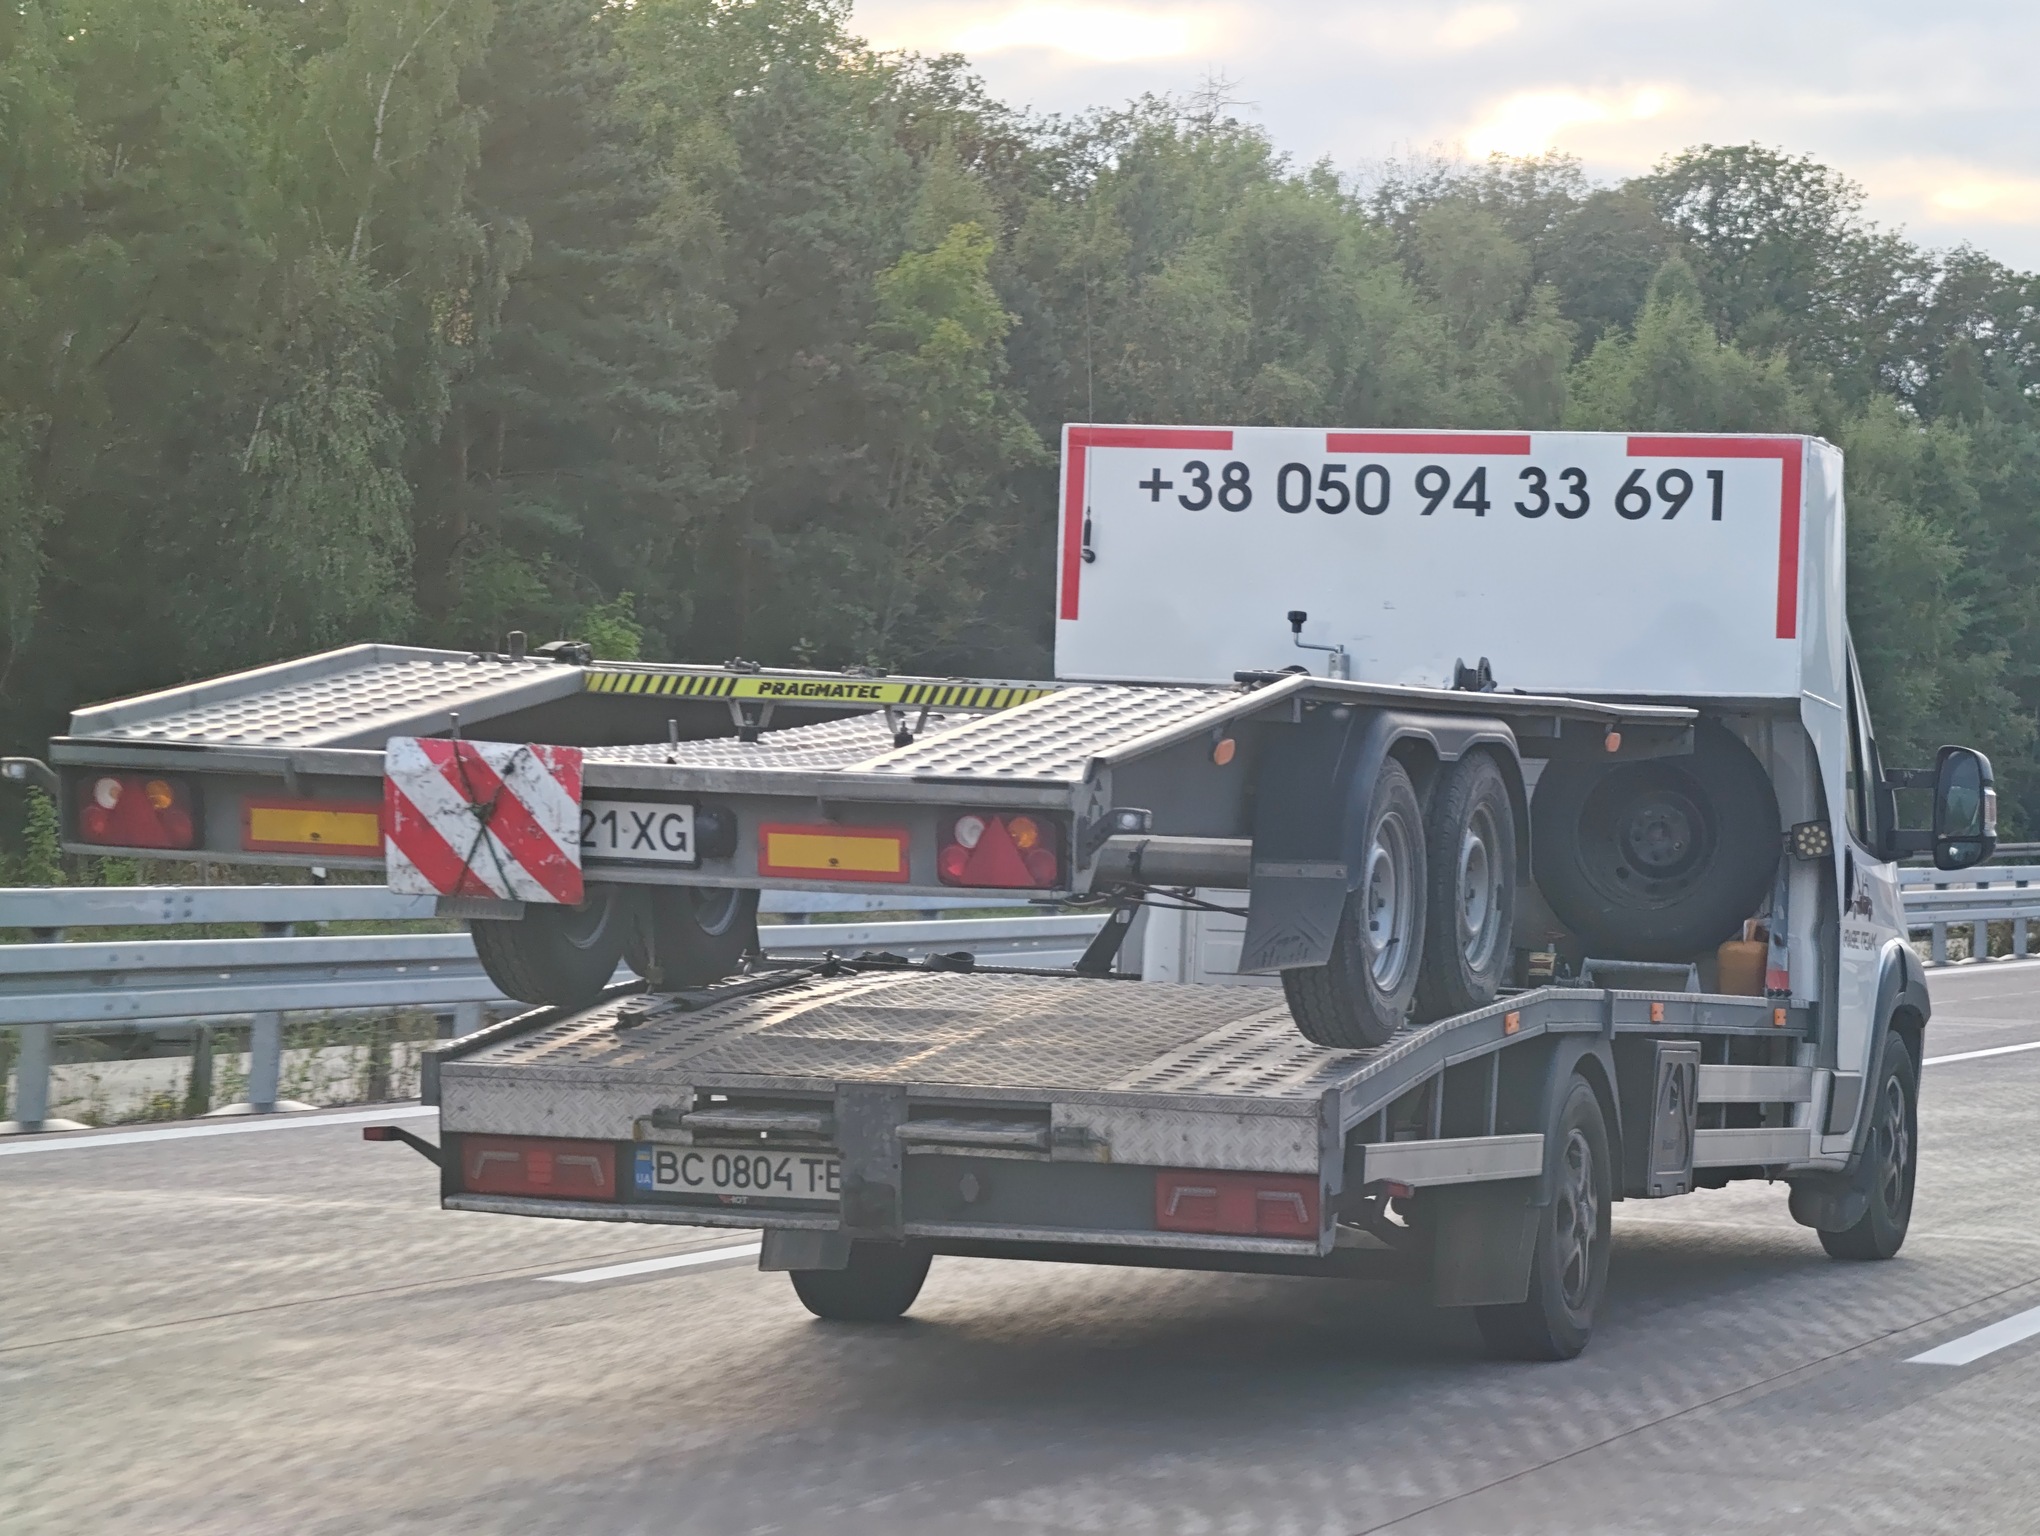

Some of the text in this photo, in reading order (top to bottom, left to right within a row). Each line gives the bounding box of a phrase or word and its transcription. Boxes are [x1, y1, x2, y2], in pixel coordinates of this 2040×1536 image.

[1139, 460, 1724, 521] +38 050 94 33 691
[757, 681, 883, 699] PRAGMATEC
[635, 1173, 652, 1184] UA
